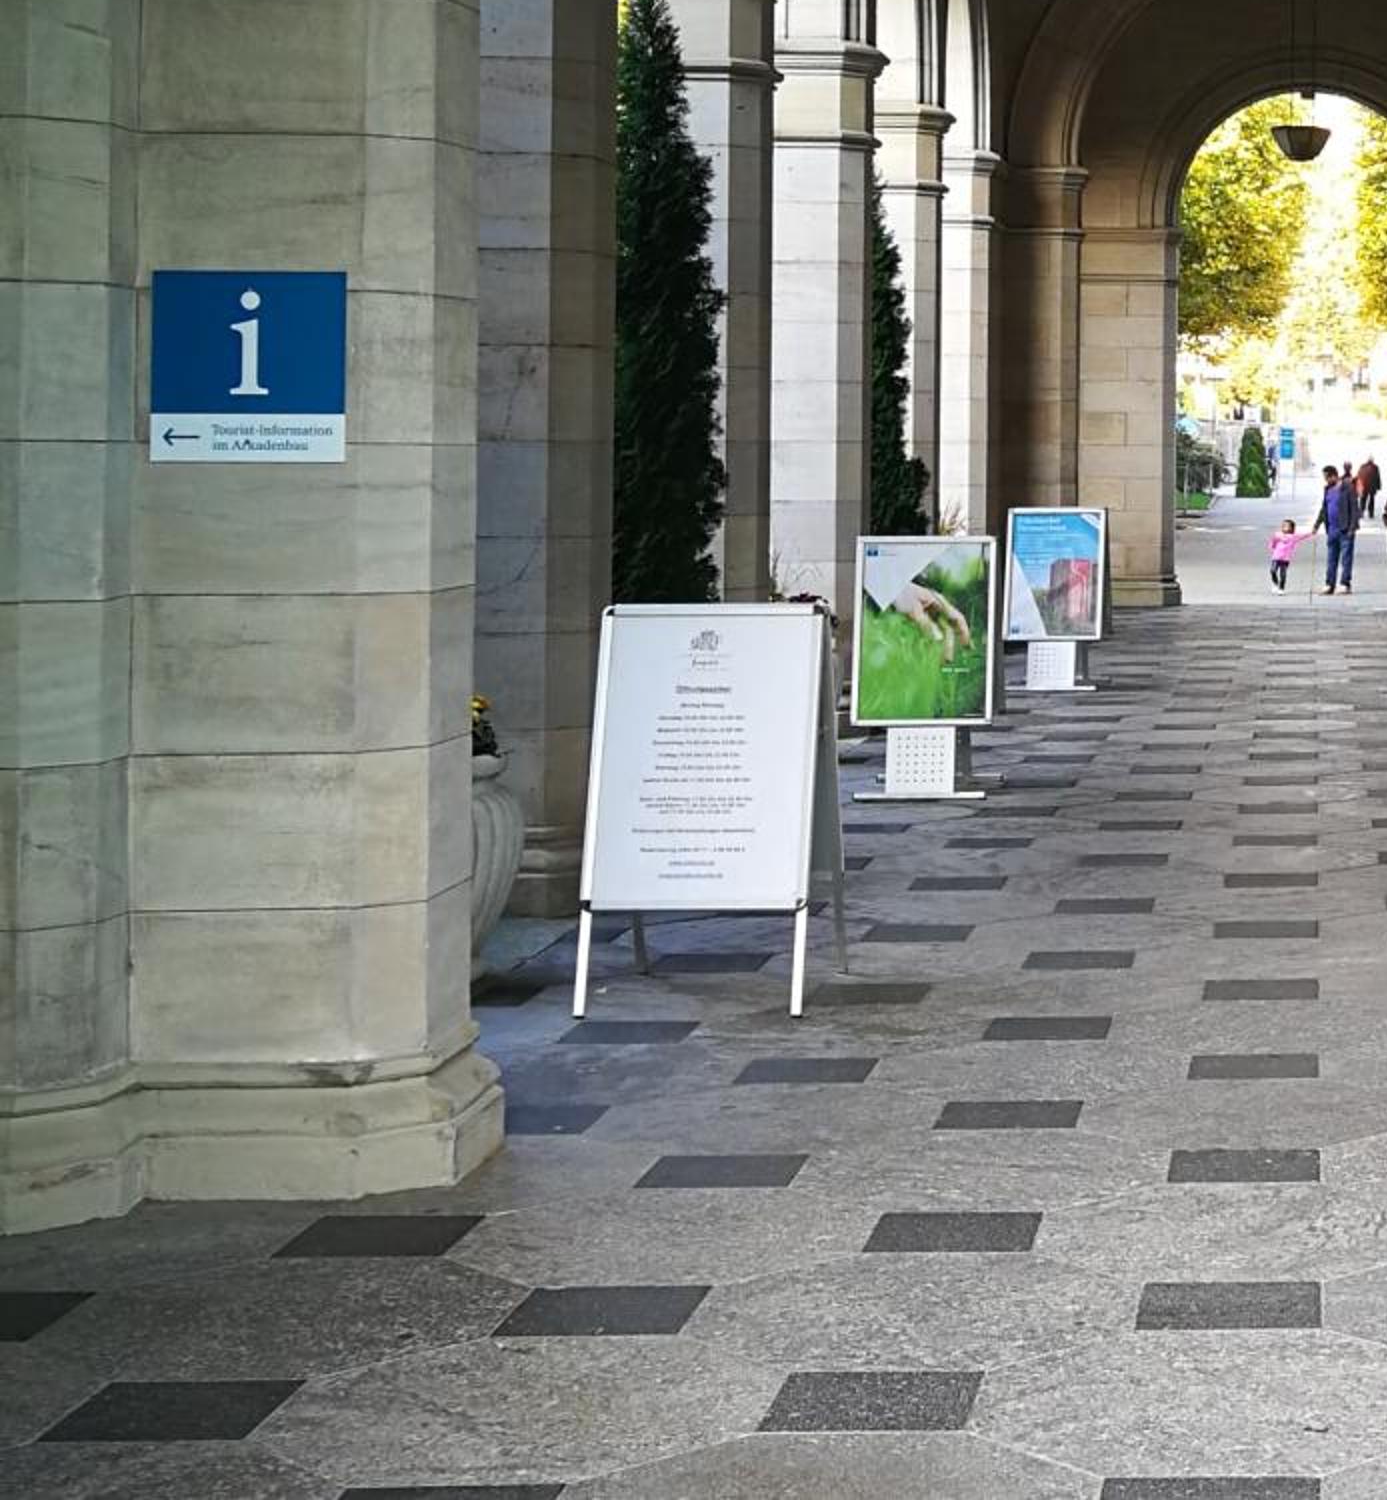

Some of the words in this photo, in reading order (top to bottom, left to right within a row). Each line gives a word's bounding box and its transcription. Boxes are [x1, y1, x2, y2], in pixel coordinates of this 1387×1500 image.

[211, 423, 333, 436] Tourist-Information
[212, 440, 229, 451] im
[232, 439, 309, 451] Arkadenbau
